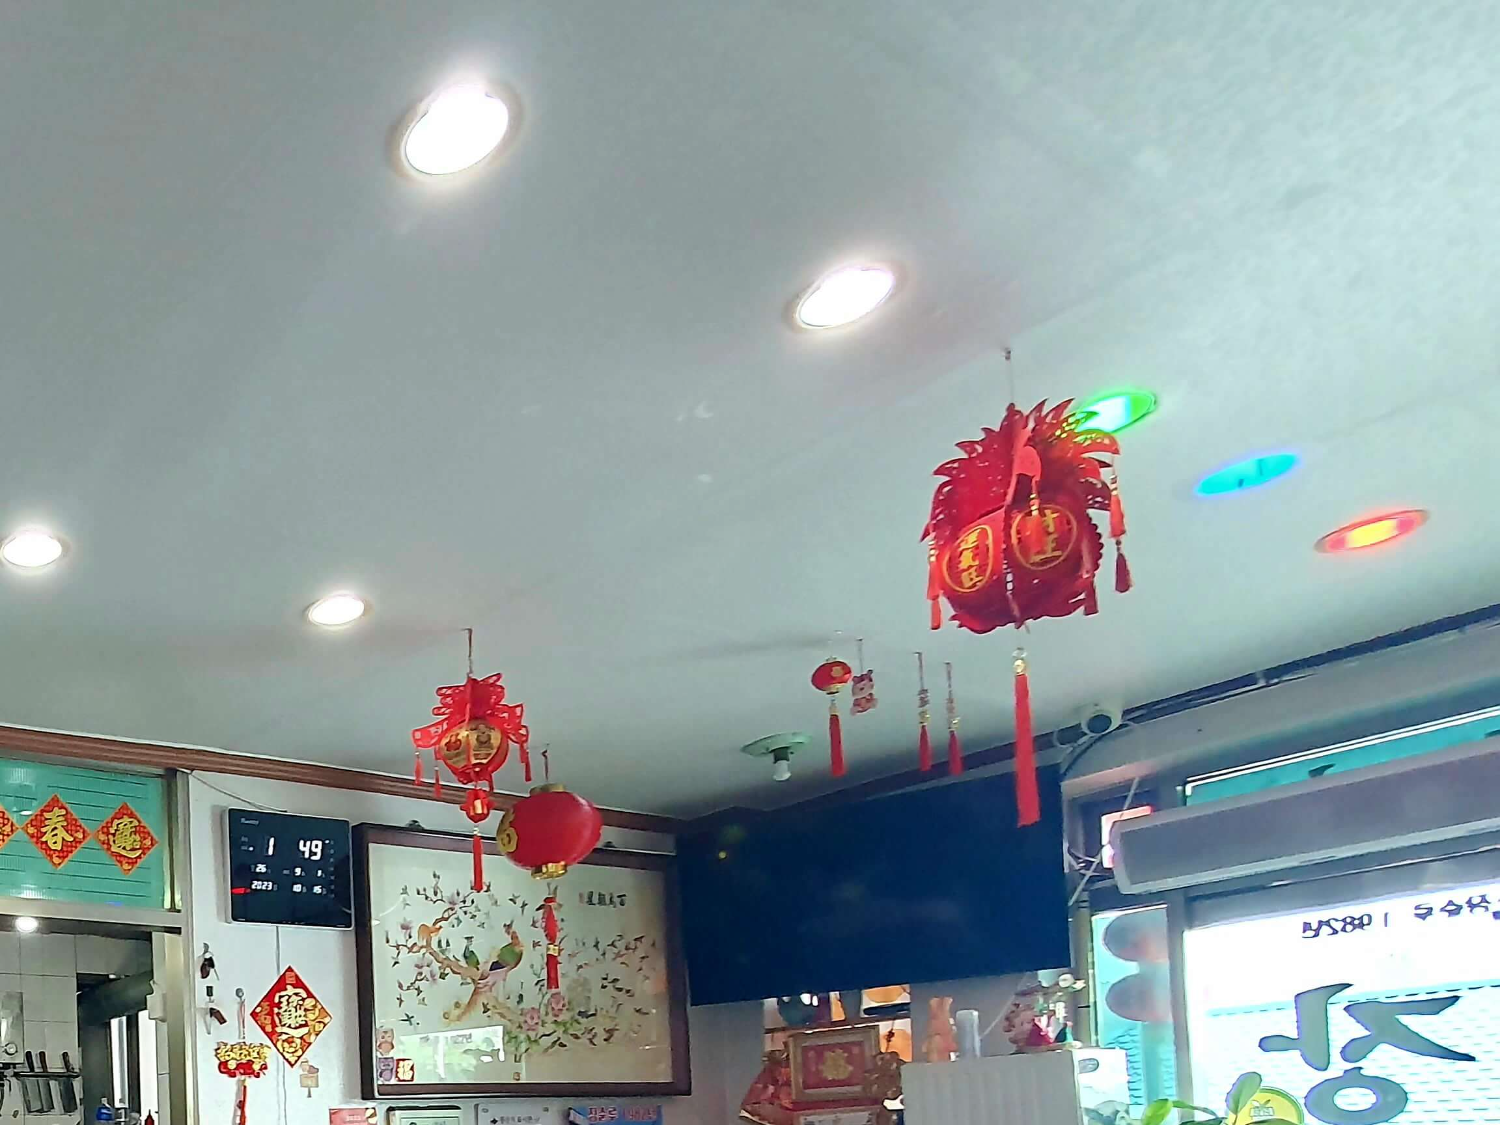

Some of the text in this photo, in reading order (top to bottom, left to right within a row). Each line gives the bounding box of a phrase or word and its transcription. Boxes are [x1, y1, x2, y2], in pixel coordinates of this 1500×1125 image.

[40, 807, 75, 851] 春
[298, 839, 323, 860] 49
[251, 880, 273, 891] 2023
